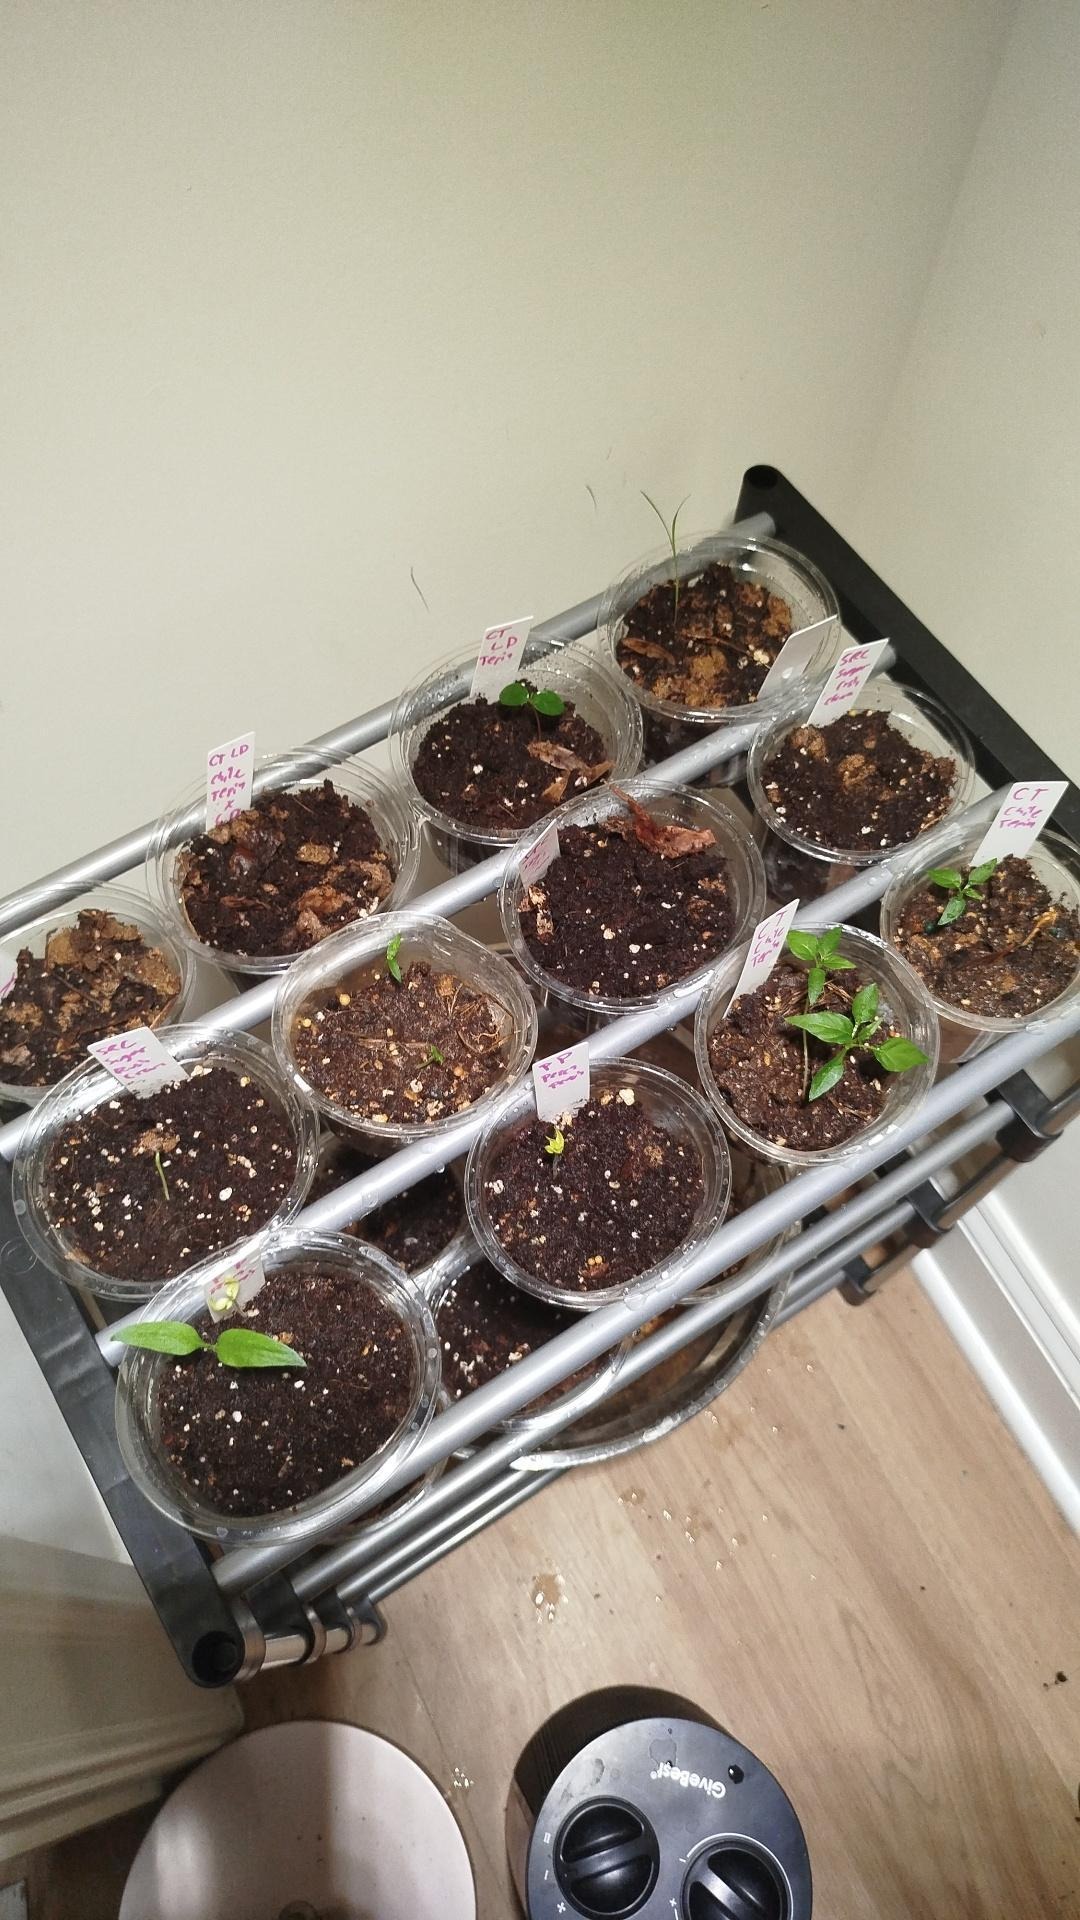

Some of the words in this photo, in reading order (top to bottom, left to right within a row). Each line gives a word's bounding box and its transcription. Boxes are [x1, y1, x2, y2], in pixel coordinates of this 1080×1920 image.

[485, 626, 513, 640] CT
[208, 753, 226, 767] CT
[1013, 787, 1049, 802] CT
